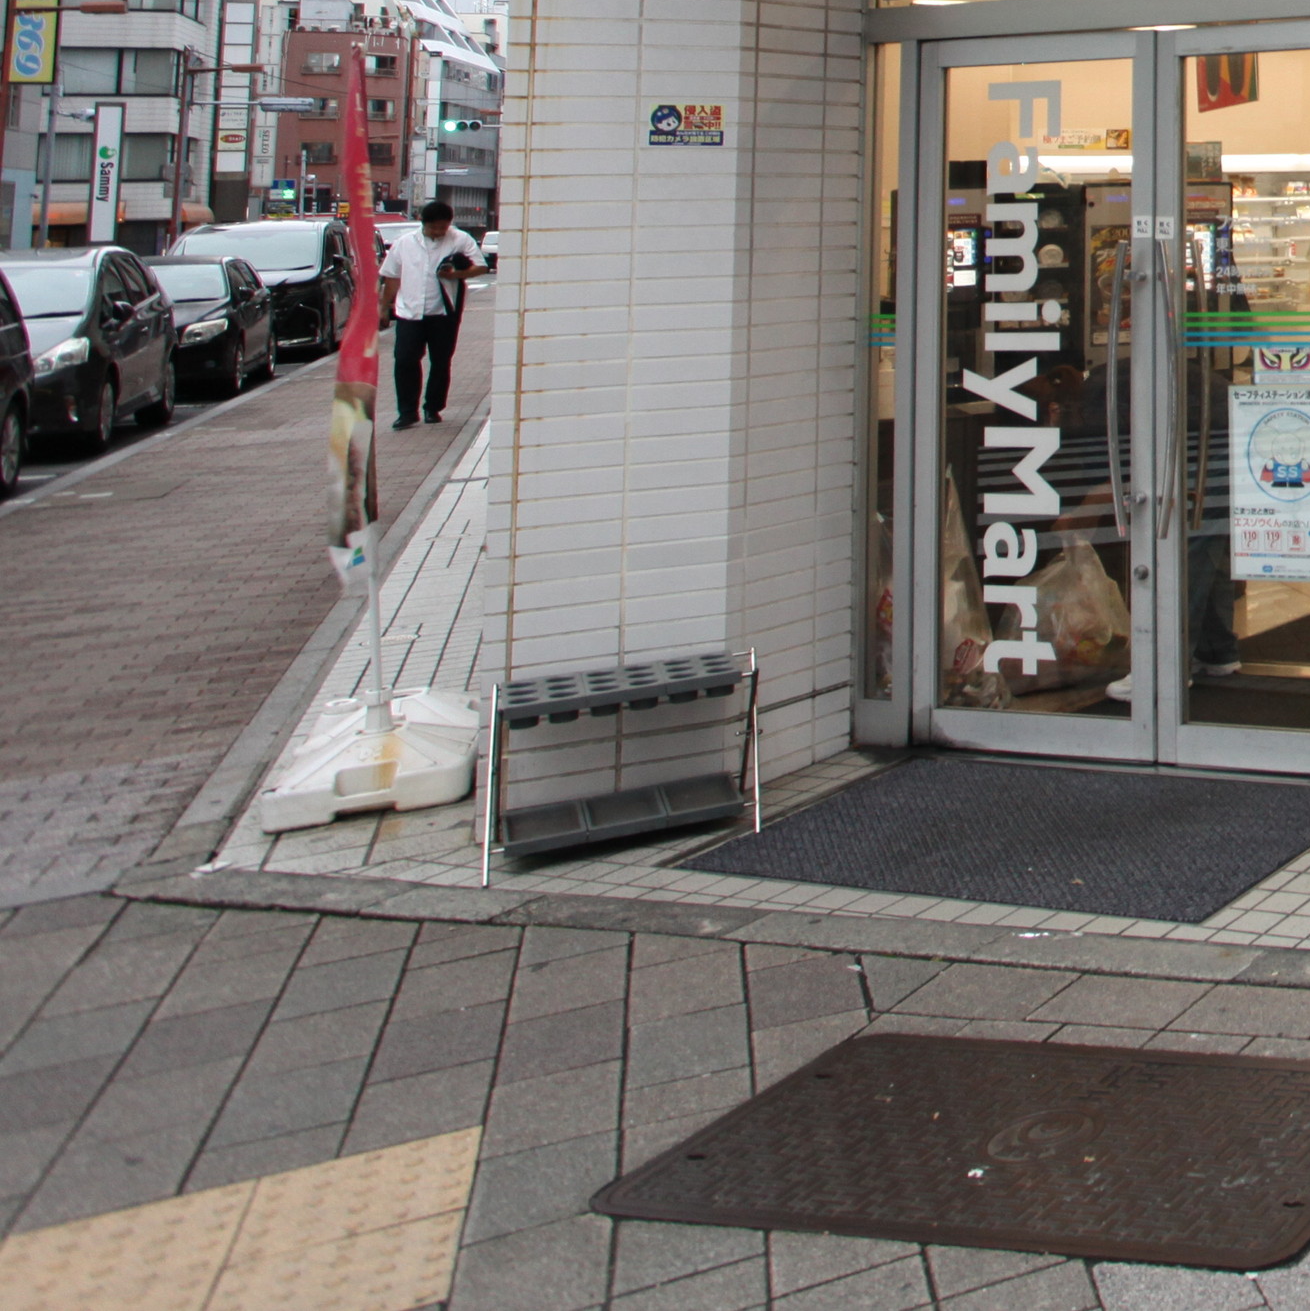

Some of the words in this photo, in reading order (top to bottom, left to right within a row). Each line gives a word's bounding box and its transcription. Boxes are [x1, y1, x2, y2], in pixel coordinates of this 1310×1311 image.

[96, 161, 114, 203] Sammy
[962, 79, 1062, 675] FamilyMart
[1243, 531, 1257, 540] 110
[1266, 531, 1280, 541] 119
